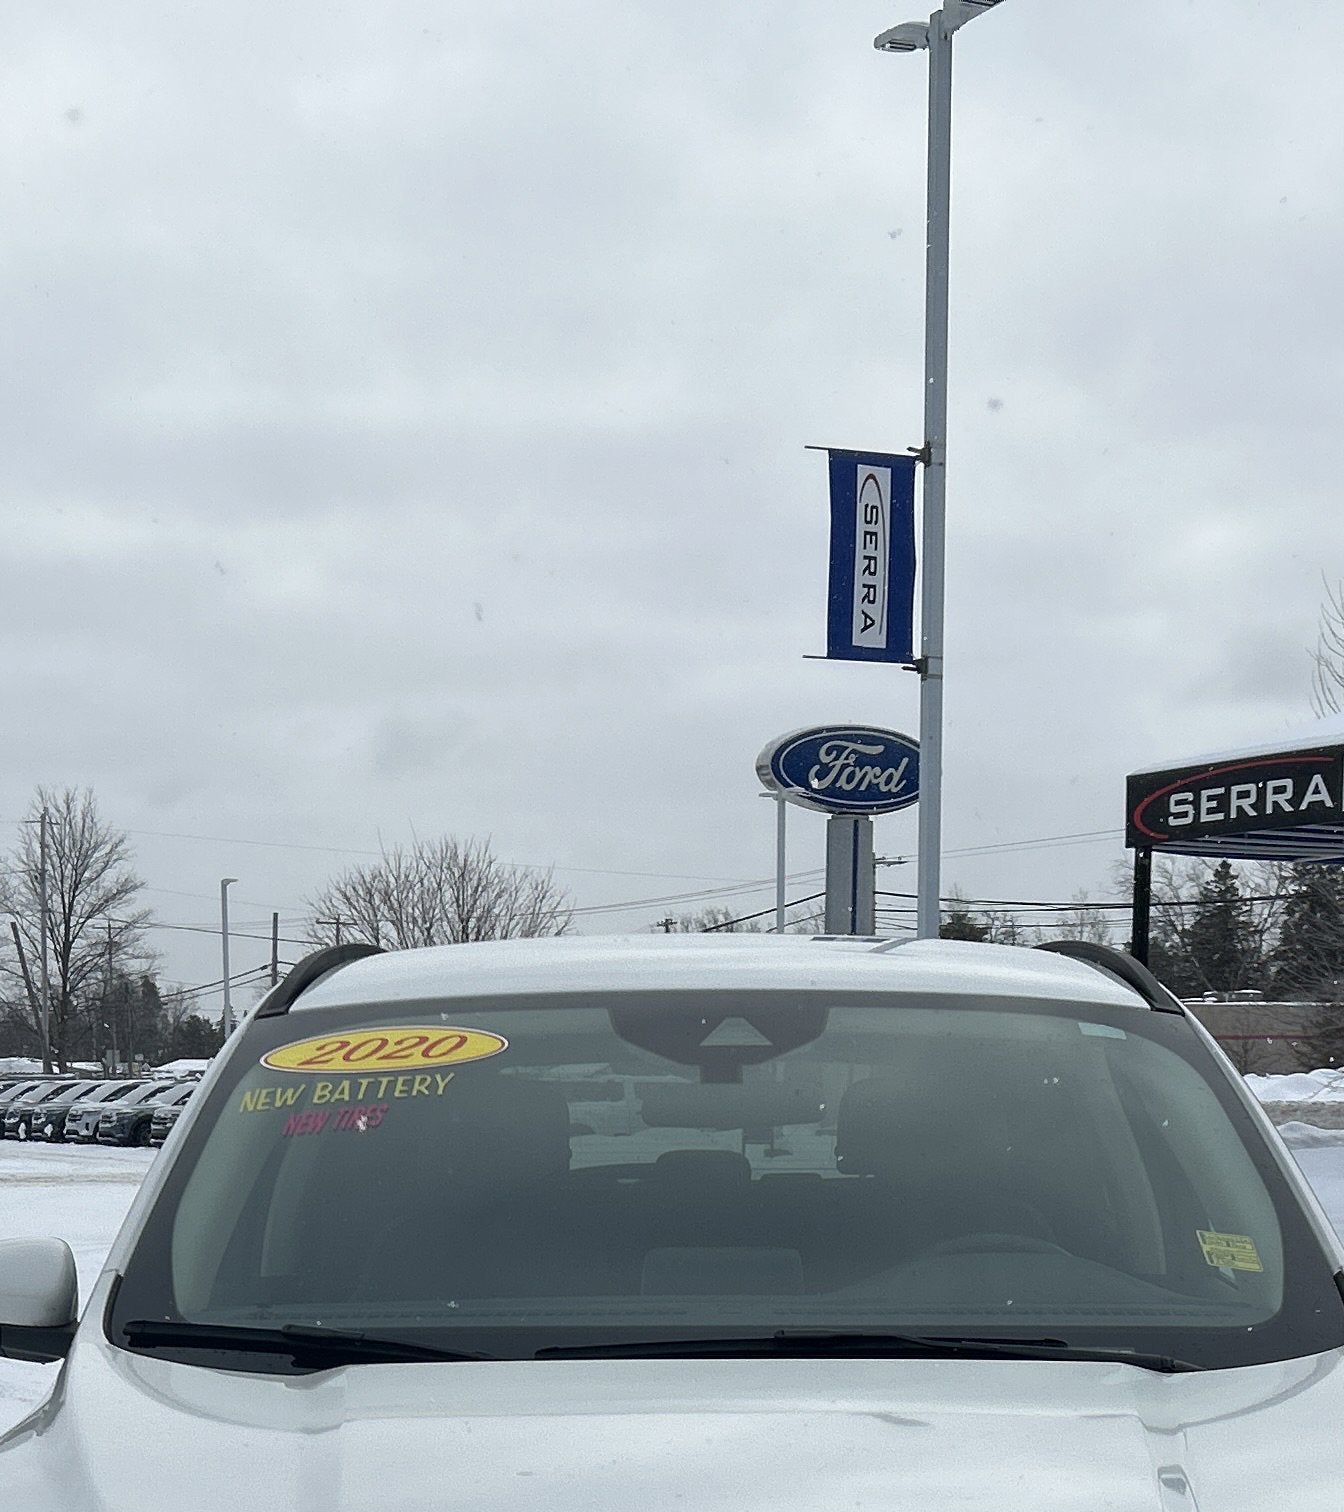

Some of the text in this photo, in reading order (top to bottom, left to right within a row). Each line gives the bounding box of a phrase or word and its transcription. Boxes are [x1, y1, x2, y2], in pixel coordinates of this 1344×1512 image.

[859, 502, 879, 634] SERRA
[808, 740, 909, 793] Ford
[1167, 773, 1335, 827] SERRA
[296, 1034, 469, 1066] 2020
[239, 1072, 455, 1113] NEW BATTERY
[281, 1109, 331, 1137] NEW
